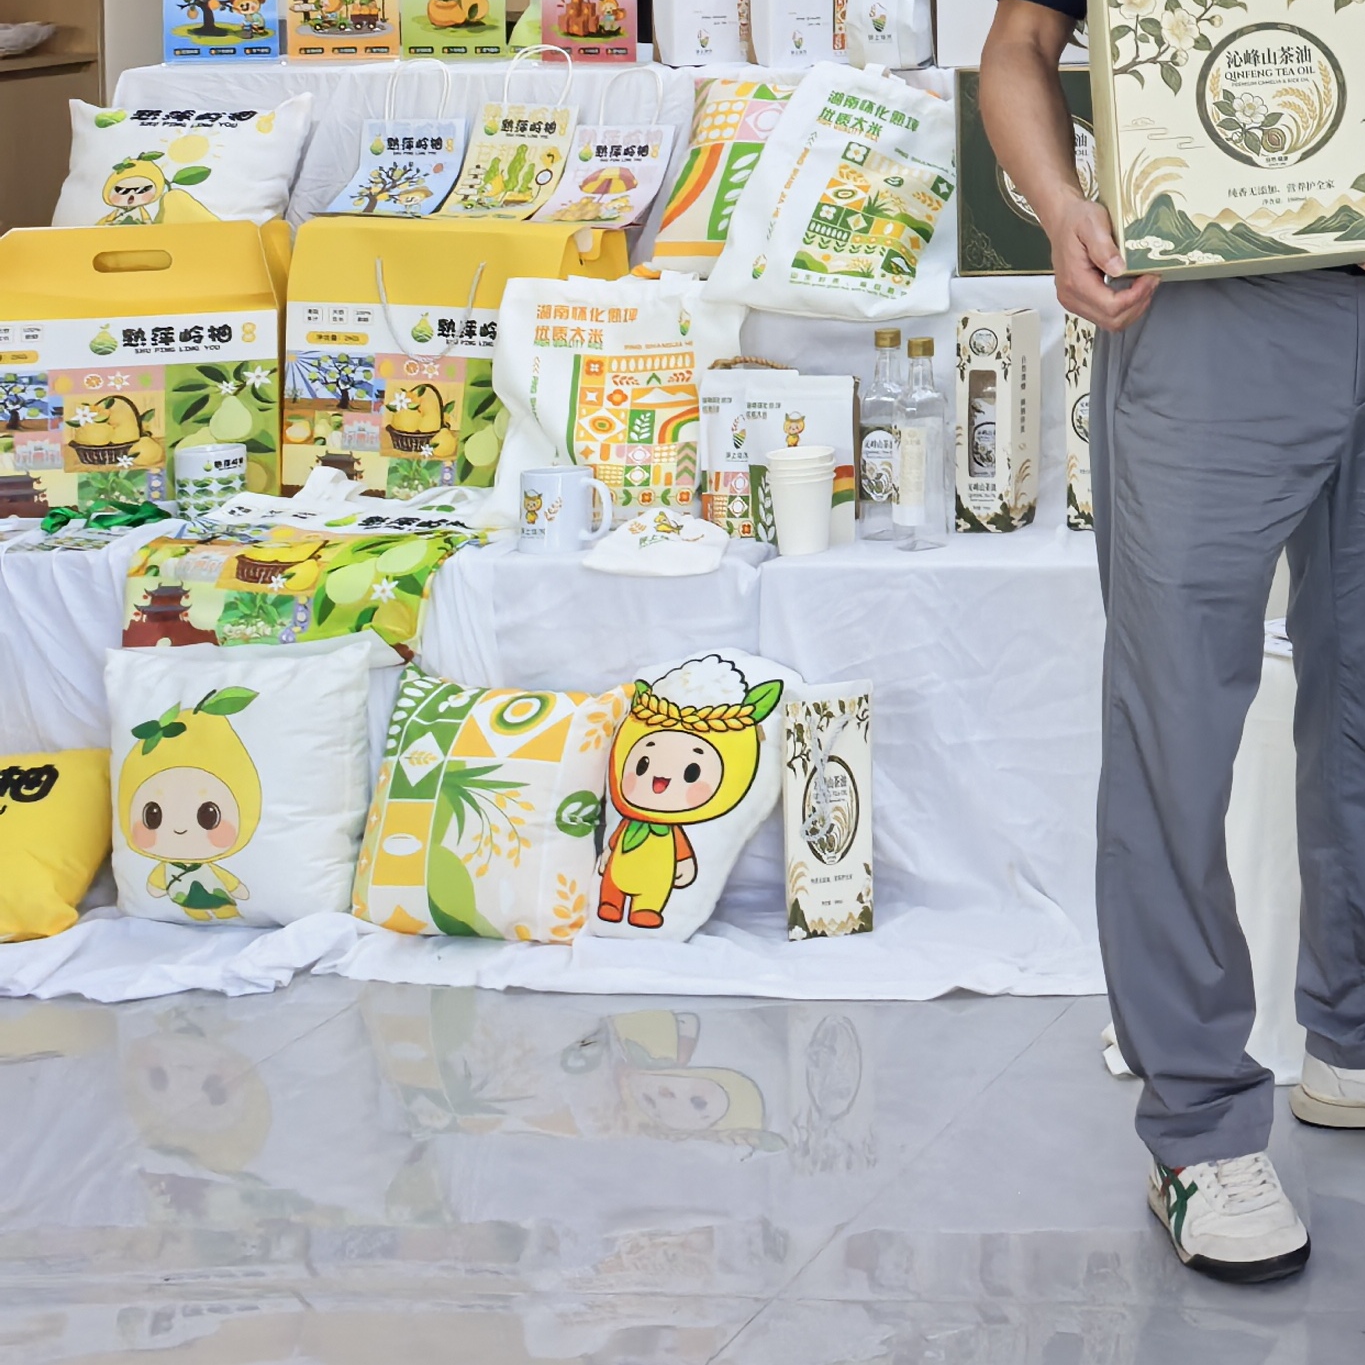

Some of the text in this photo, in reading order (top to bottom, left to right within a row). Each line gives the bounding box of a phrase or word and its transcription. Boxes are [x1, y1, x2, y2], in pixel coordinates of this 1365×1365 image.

[1225, 44, 1312, 69] 沁峰山茶油
[1224, 65, 1315, 82] QINFENG TEA OIL
[818, 106, 883, 138] 优质大米
[536, 304, 638, 324] 湖南怀化熟坪
[534, 325, 604, 346] 优质大米
[179, 345, 200, 353] LING
